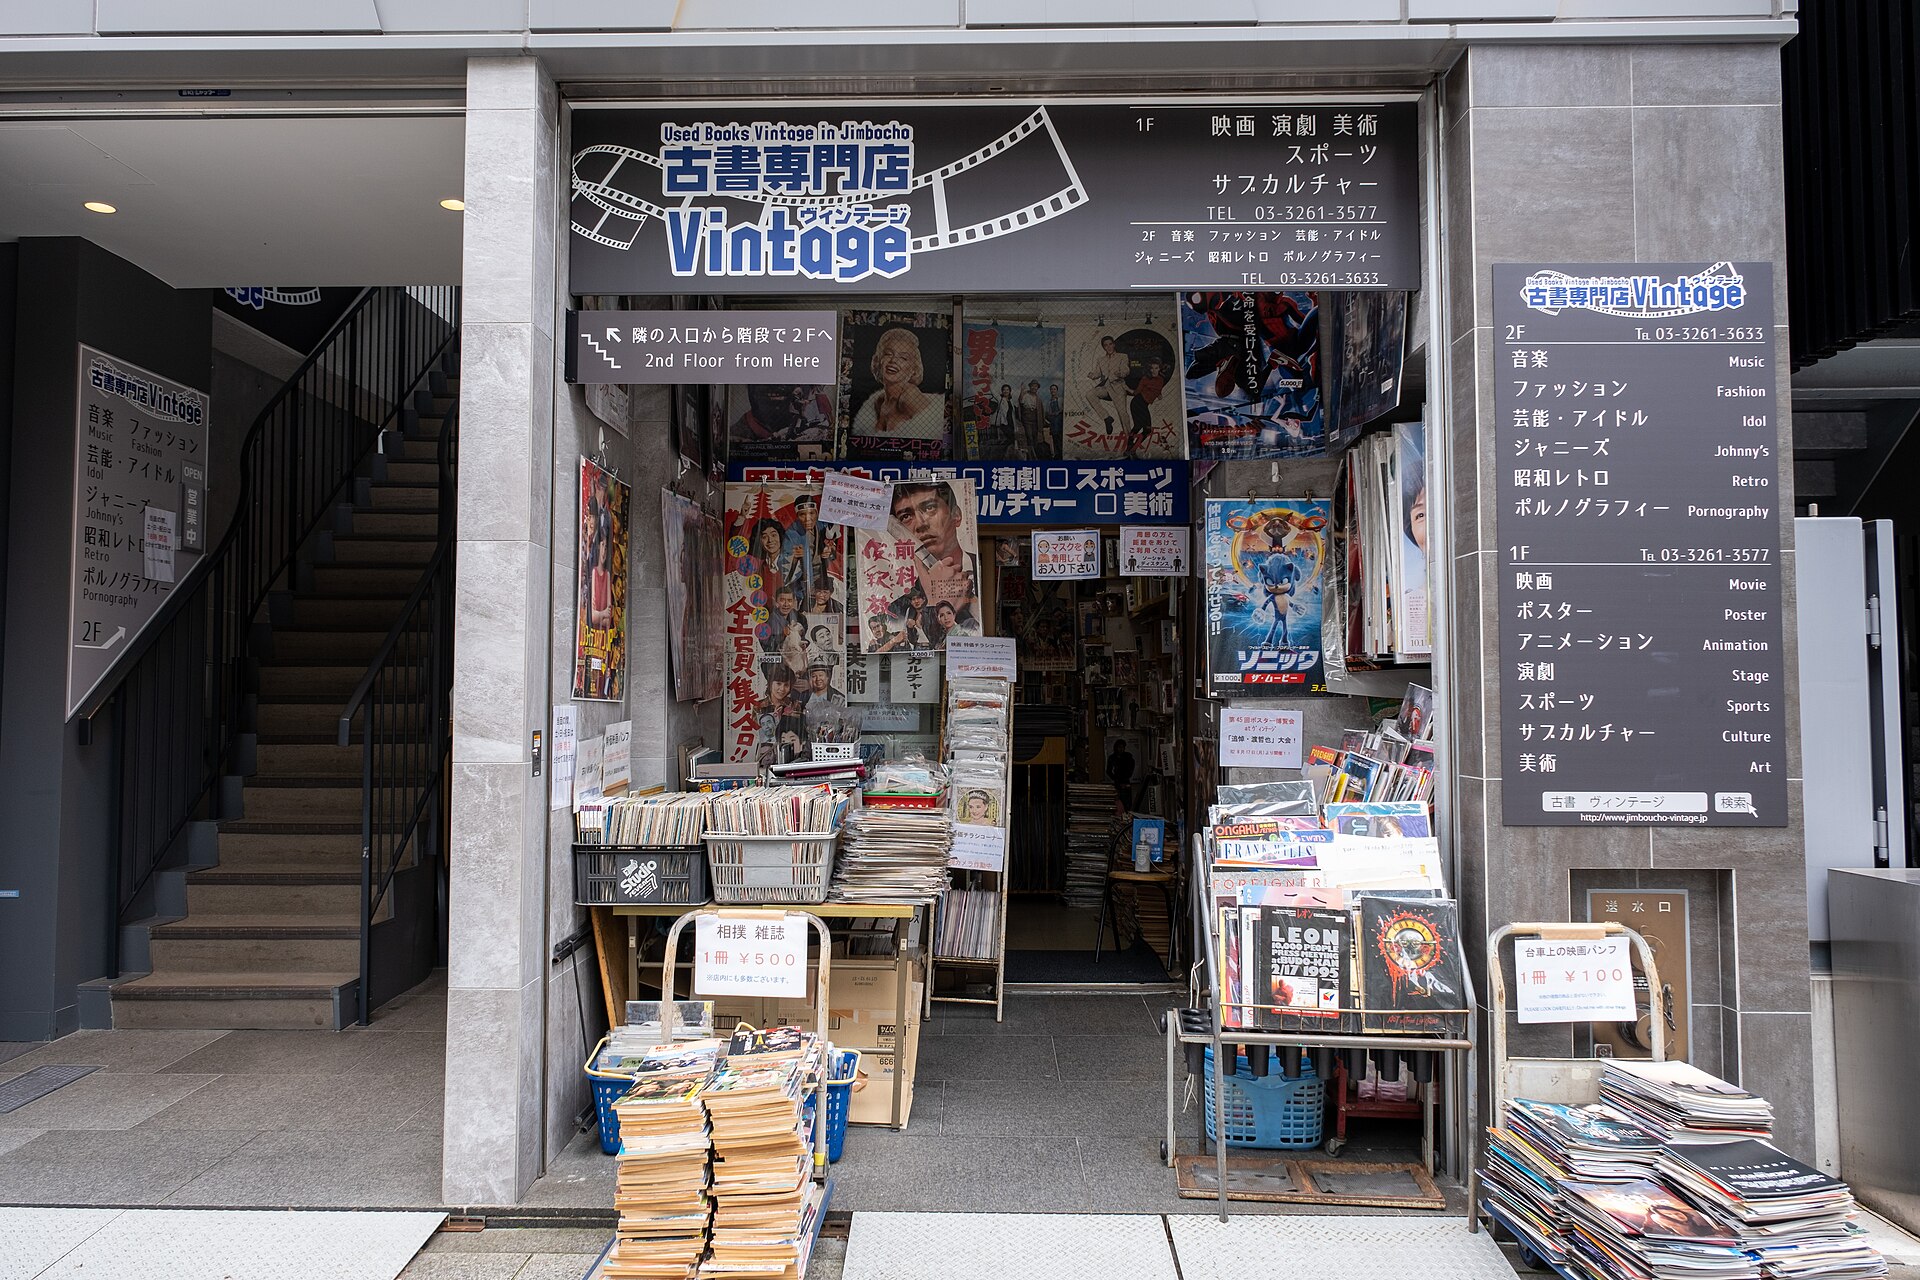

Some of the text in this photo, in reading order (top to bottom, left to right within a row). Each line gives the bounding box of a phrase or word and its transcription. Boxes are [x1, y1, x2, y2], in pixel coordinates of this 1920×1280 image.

[1135, 117, 1154, 132] 1F
[1211, 114, 1378, 137] 映画 演劇 美術
[664, 126, 911, 143] Used Books Vintage in Jimbocho
[1286, 143, 1377, 165] スポーツ
[664, 145, 911, 193] 古書専門店
[1212, 173, 1378, 195] サブカルチャー
[800, 207, 909, 225] ヴィンテージ
[1206, 206, 1378, 220] TEL 03-3261-3577
[666, 209, 909, 279] Vintage
[1142, 229, 1381, 243] 2F 音楽 ファッション 芸能・アイドル
[1134, 250, 1381, 265] ジャニーズ 昭和レトロ ポルノグラフィー
[1241, 272, 1379, 285] TEL 03-3261-3633
[1564, 278, 1590, 286] Vintage
[1527, 277, 1743, 310] 古書専門店 Vintage
[632, 327, 833, 344] 隣の入口から階段で2Fへ
[1505, 325, 1764, 340] 2F TEL 03-3261-3633
[1243, 291, 1258, 395] 命を受け入れろ。
[645, 353, 820, 368] 2nd Floor from Here
[1511, 350, 1548, 368] 音楽
[1729, 356, 1765, 368] Music
[91, 369, 148, 405] 古書専門店
[149, 382, 202, 425] Vintage
[1513, 380, 1628, 398] ファッション
[1716, 386, 1766, 397] Fashion
[1513, 409, 1649, 428] 芸能・アイドル
[1742, 415, 1766, 427] Idol
[88, 403, 198, 453] 音楽 ファッション
[89, 425, 162, 457] Music Fashion
[1515, 438, 1610, 457] ジャニーズ
[1714, 444, 1769, 458] Johnny's
[87, 443, 175, 484] 芸能・アイドル
[87, 465, 104, 480] Idol
[184, 466, 203, 481] OPEN
[991, 467, 1041, 491] 演劇
[1076, 467, 1173, 491] スポーツ
[1514, 469, 1609, 487] 昭和レトロ
[1732, 475, 1769, 487] Retro
[1123, 491, 1173, 517] 美術
[1515, 498, 1670, 517] ポルノグラフィー
[1688, 505, 1769, 520] Pornography
[86, 506, 123, 526] Johnny's
[186, 488, 198, 544] 営業中
[84, 547, 110, 562] Retro
[1051, 543, 1082, 552] マスクを
[1509, 546, 1769, 561] 1F TEL 03-3261-3577
[1051, 554, 1082, 563] 着用して
[1038, 563, 1095, 575] お入り下さい
[83, 566, 170, 595] ポルノグラフィー
[1516, 572, 1552, 590] 映画
[1729, 578, 1767, 590] Movie
[83, 588, 139, 609] Pornography
[1517, 601, 1593, 620] ポスター
[1724, 609, 1767, 621] Poster
[82, 620, 102, 642] 2F
[1518, 632, 1654, 650] アニメーション
[1703, 639, 1768, 651] Animation
[1237, 650, 1320, 671] ソニック
[1251, 674, 1298, 683] ザ・ムービー
[1517, 662, 1554, 682] 演劇
[1732, 670, 1769, 684] Stage
[1519, 692, 1594, 711] スポーツ
[1726, 700, 1770, 714] Sports
[1519, 723, 1655, 742] サブカルチャー
[1722, 730, 1771, 742] Culture
[1519, 753, 1557, 773] 美術
[1749, 761, 1772, 773] Art
[1551, 795, 1747, 809] 古書 ヴィンテージ 検索
[1580, 812, 1708, 823] http://www.jimboucho-vintage.jp
[620, 860, 657, 895] Studio
[1296, 908, 1313, 919] レオン
[1606, 900, 1671, 913] 送水口
[716, 924, 785, 941] 相撲 雑誌
[1272, 926, 1339, 946] LEON
[1272, 949, 1339, 960] PRESS MEETING
[1304, 944, 1339, 953] PEOPLE
[1525, 944, 1617, 958] 台車上の映画パンフ
[704, 950, 796, 967] 1冊 ¥500
[1272, 964, 1339, 978] 2/17 1995
[1520, 968, 1623, 985] 1冊 ¥100
